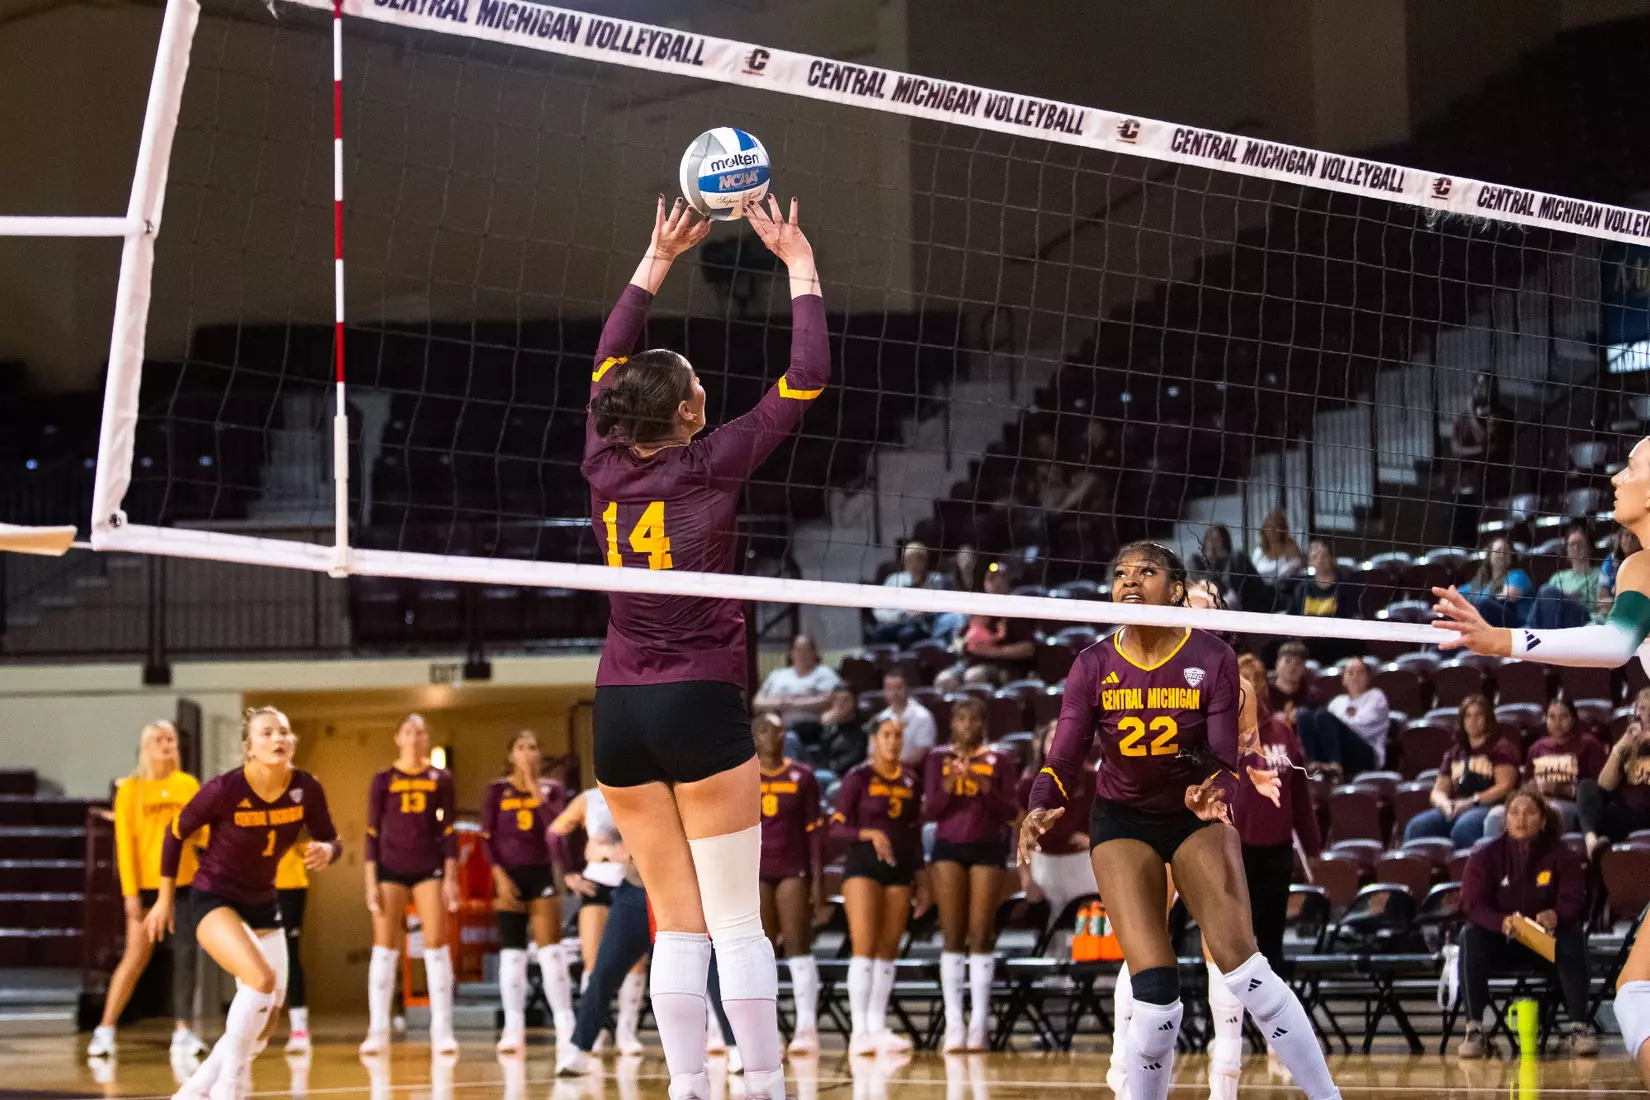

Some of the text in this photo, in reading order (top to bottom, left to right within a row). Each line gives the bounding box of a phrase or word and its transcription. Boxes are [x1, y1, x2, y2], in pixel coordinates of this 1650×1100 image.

[374, 0, 705, 66] TRAL MICHIGAN VOLLEYBALL
[807, 60, 1085, 135] CENTRAL MICHIGAN VOLLEYBALL
[710, 153, 759, 172] molten
[1171, 127, 1405, 193] CENTRAL MICHIGAN VOLLEYBALL
[719, 170, 759, 189] NCAA
[1477, 185, 1650, 238] CENTRAL MICHIGAN VOLLEY
[602, 501, 673, 570] 14
[1101, 687, 1200, 711] CENTRAL MICHIGAN
[1117, 715, 1179, 757] 22
[400, 791, 427, 814] 13
[888, 797, 902, 819] 3
[262, 829, 277, 857] 1
